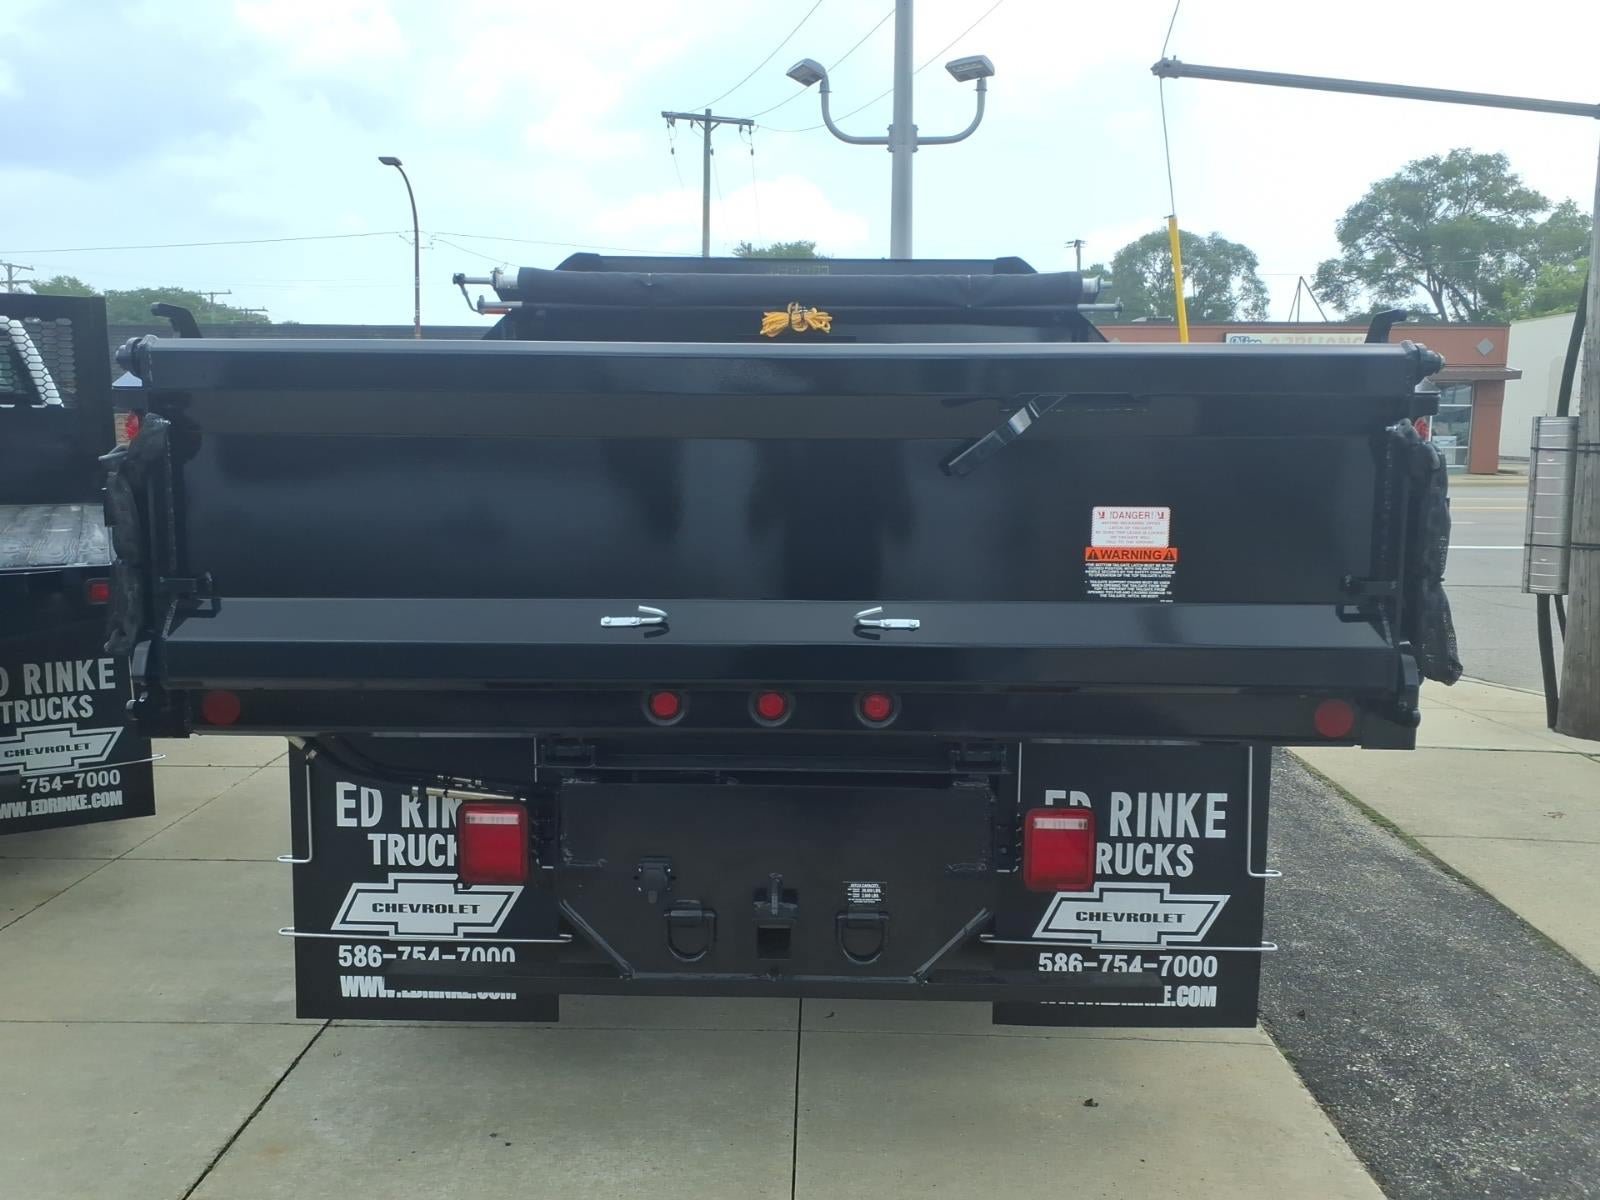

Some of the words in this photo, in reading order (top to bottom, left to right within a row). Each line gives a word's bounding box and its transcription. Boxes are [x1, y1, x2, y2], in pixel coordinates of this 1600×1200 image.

[1100, 550, 1162, 560] WARNING
[23, 658, 116, 696] RINKE
[0, 695, 94, 724] TRUCKS
[4, 742, 91, 758] CHEVROLET
[22, 769, 121, 794] 754-7000
[0, 790, 123, 819] WW.EDRINKE.COM
[336, 782, 383, 827] ED
[401, 794, 463, 828] RIN
[1110, 791, 1228, 838] RINKE
[367, 833, 458, 867] TRUCK
[1096, 842, 1194, 877] RUCKS
[372, 902, 480, 915] CHEVROLET
[1075, 911, 1186, 924] CHEVROLET
[1038, 952, 1218, 978] 586-754-7000
